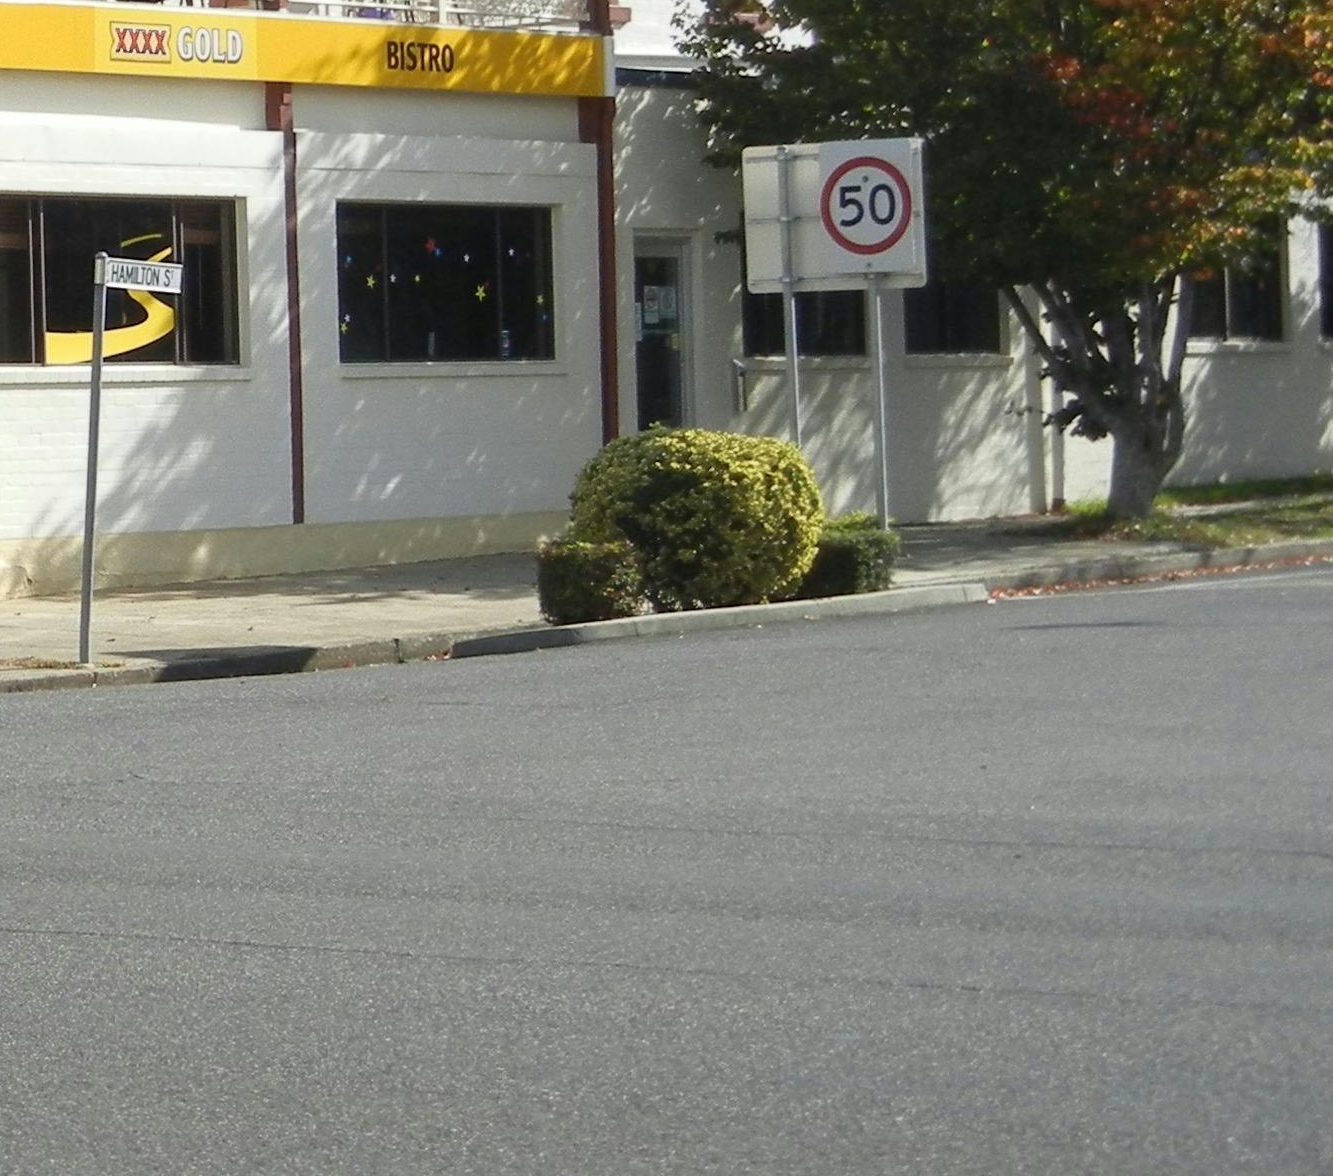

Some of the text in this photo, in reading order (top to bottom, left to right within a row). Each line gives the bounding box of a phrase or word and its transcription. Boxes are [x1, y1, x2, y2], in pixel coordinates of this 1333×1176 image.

[115, 26, 243, 63] XXXX GOLD
[386, 41, 454, 73] BISTRO
[839, 184, 895, 226] 50
[111, 264, 160, 286] HAMILTON
